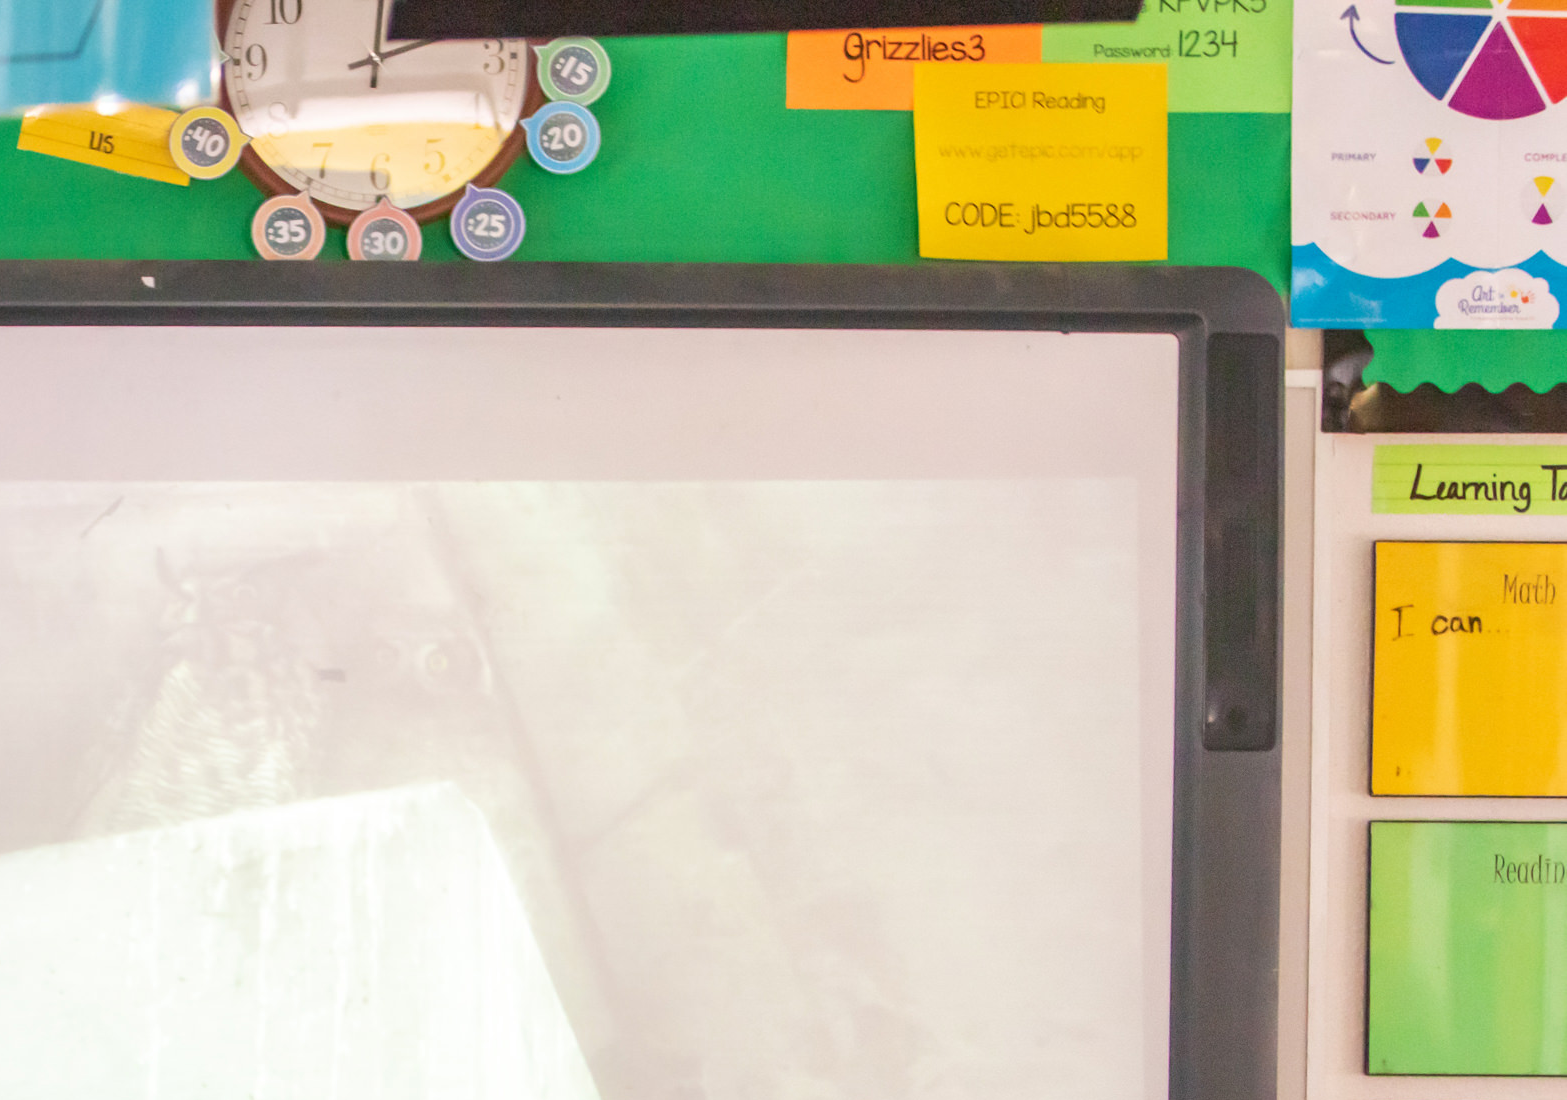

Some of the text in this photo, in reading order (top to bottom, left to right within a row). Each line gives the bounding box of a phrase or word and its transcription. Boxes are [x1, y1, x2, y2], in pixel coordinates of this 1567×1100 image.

[263, 0, 302, 25] 10
[483, 38, 505, 75] 3
[1094, 30, 1238, 58] Password 1234
[245, 43, 267, 82] 9
[555, 57, 593, 87] :15
[1032, 91, 1106, 114] Reading
[88, 131, 115, 154] us
[183, 126, 226, 158] :40
[542, 123, 583, 150] :20
[312, 142, 333, 179] 7
[423, 138, 446, 175] 5
[1331, 153, 1377, 161] PRIMARY
[369, 152, 391, 190] 6
[468, 213, 507, 239] :25
[1023, 202, 1138, 235] jbd5588
[1330, 212, 1396, 221] SECONDARY
[267, 219, 307, 244] :35
[363, 231, 405, 256] :30
[1458, 299, 1521, 315] Remember
[1472, 285, 1494, 301] Art
[1410, 463, 1531, 513] Learning
[1503, 574, 1556, 604] Math
[1391, 604, 1414, 640] I
